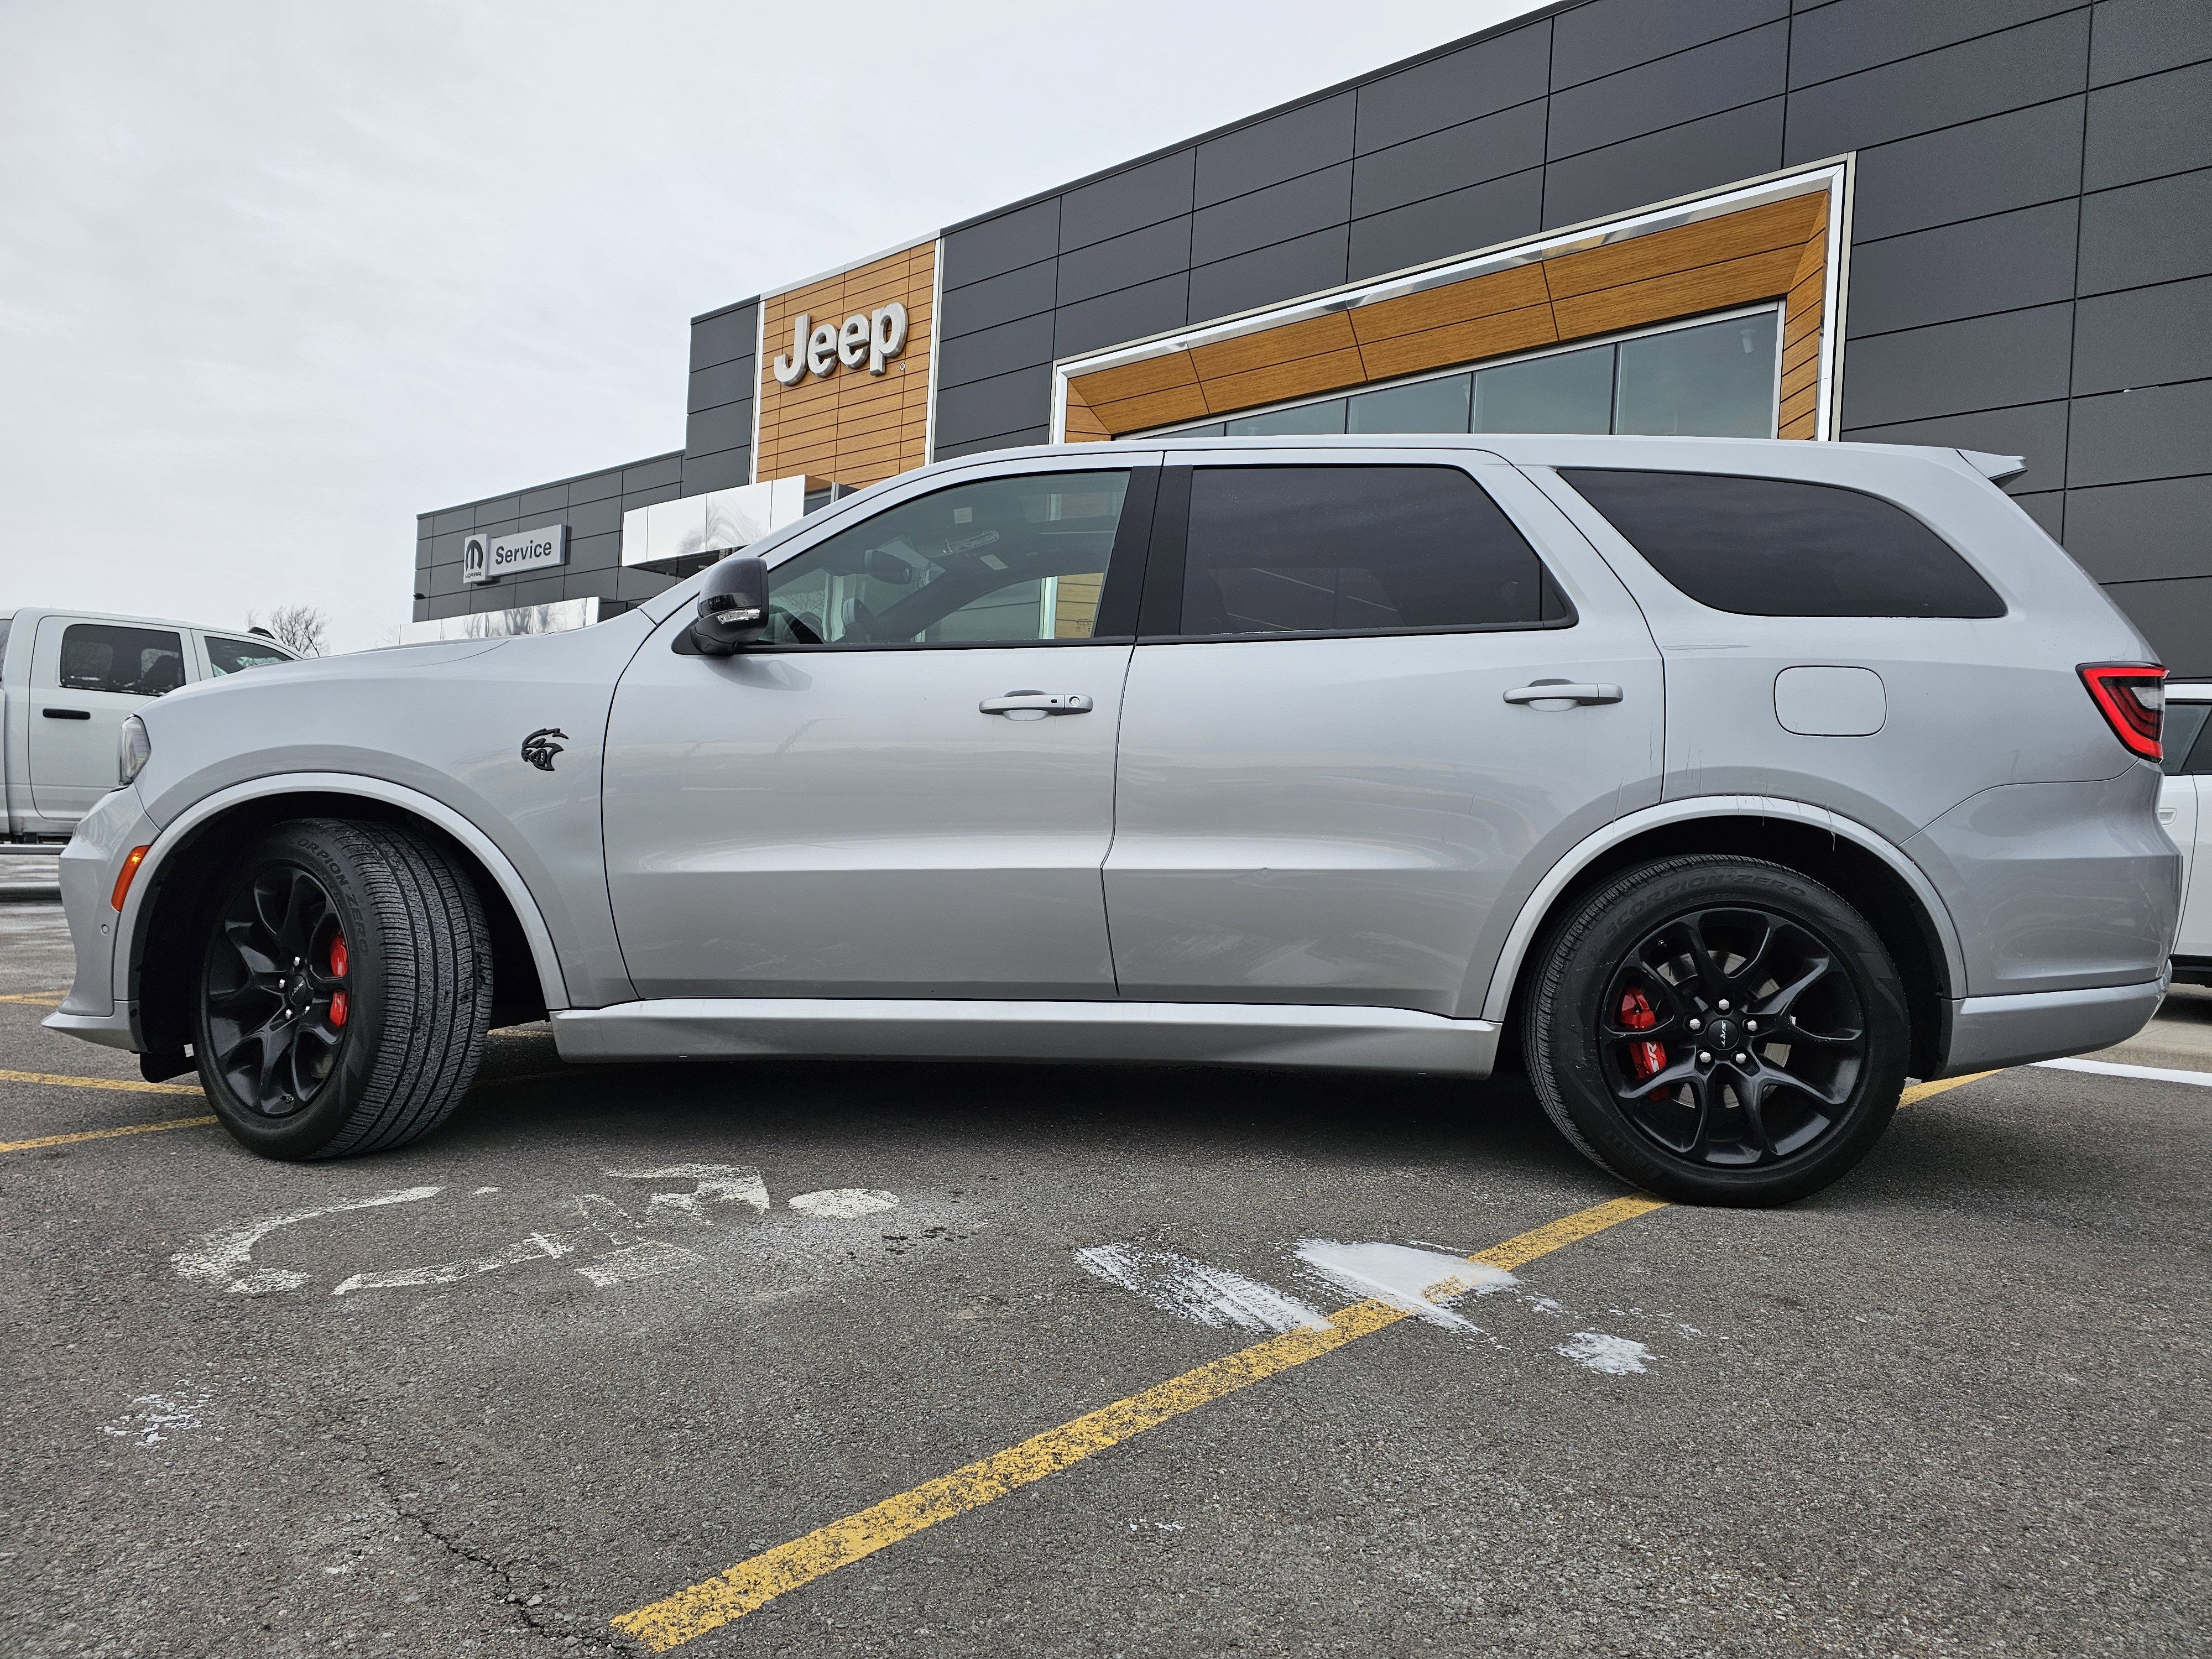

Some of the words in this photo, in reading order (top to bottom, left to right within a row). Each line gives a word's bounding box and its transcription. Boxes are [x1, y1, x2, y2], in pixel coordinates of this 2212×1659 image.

[774, 302, 909, 386] Jeep
[495, 540, 552, 565] Service
[1733, 874, 1807, 897] ZERO
[345, 894, 368, 955] ZERO
[1646, 1041, 1660, 1073] SR
